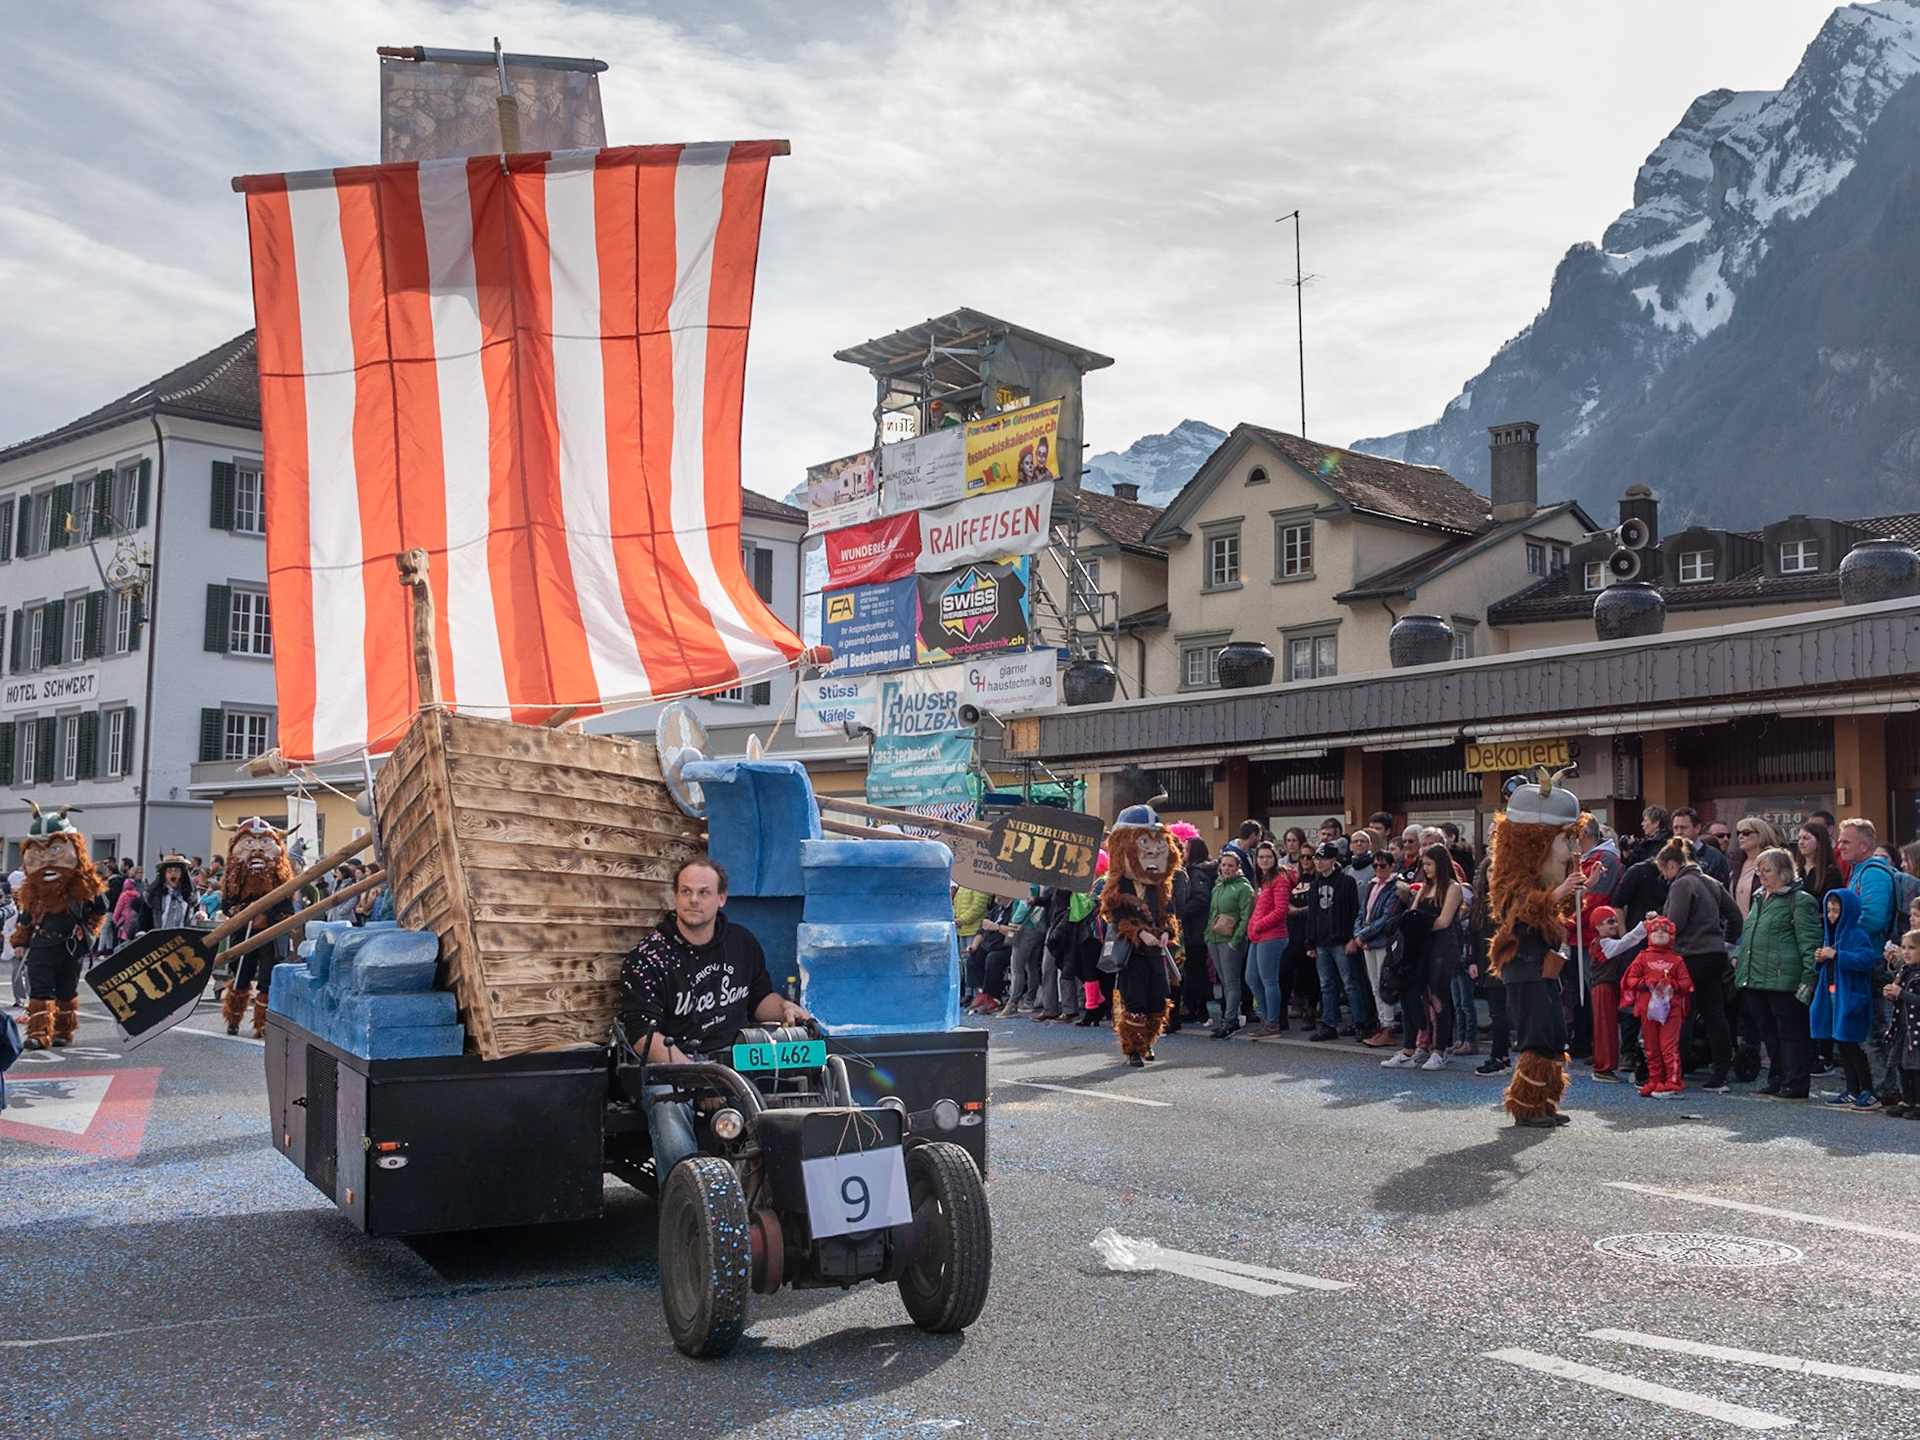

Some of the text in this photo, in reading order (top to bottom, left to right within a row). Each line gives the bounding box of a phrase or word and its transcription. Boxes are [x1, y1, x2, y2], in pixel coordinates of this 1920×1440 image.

[967, 418, 1057, 466] fasnachtskalender.ch
[930, 504, 1040, 555] RAIFFEISEN
[841, 540, 887, 562] WUNDERLE
[942, 588, 996, 612] SWISS
[943, 604, 995, 620] WERBETECHNIK
[849, 648, 899, 668] Bedachungen
[899, 644, 911, 660] AG
[987, 675, 1052, 692] haustechnik ag
[999, 664, 1028, 679] glarner
[6, 674, 95, 704] HOTEL SCHWERT
[819, 684, 858, 700] Stüssi
[818, 708, 856, 723] Näfels
[889, 690, 958, 717] HAUSER
[890, 711, 959, 734] HOLZBA
[1467, 739, 1566, 769] Dekoriert
[1006, 818, 1095, 847] NIEDERURNER
[972, 858, 993, 870] 8750
[996, 829, 1093, 877] PUB
[97, 935, 187, 994] NIEDERURNER
[102, 945, 206, 1022] PUB
[720, 975, 750, 1006] Sam
[750, 1045, 811, 1066] GL 462
[840, 1175, 871, 1223] 9
